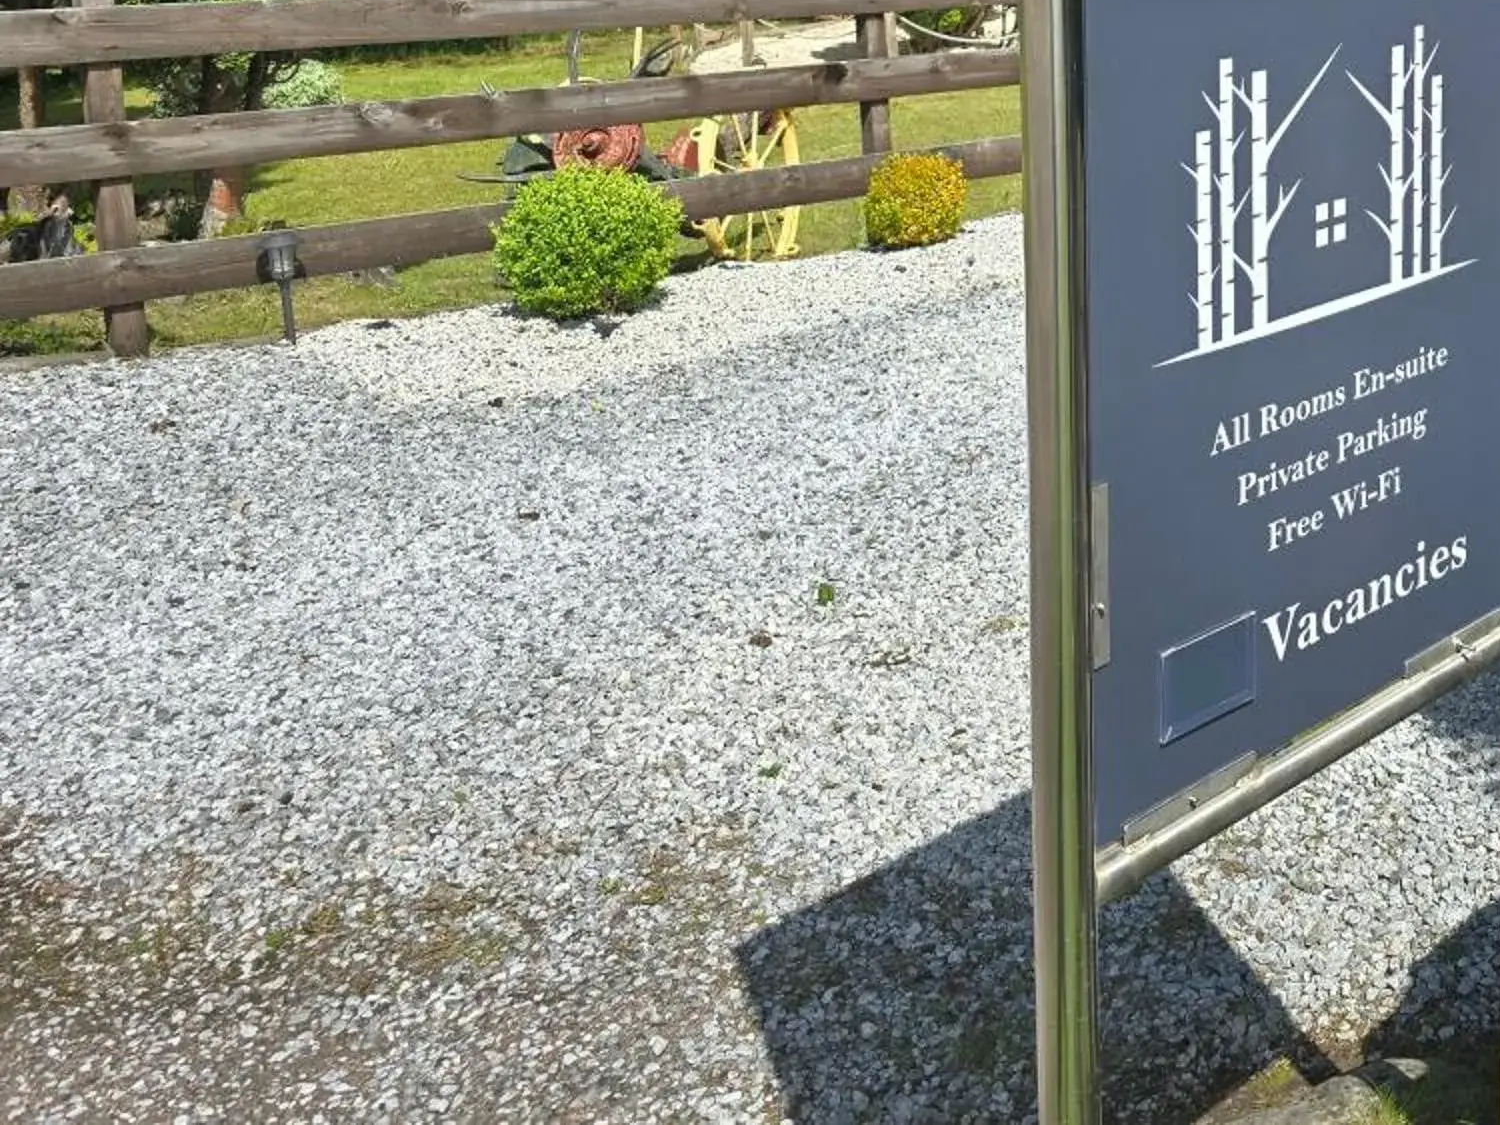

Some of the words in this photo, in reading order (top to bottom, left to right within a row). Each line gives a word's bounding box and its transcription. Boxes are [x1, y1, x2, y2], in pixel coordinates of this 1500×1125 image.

[1209, 412, 1251, 457] All
[1259, 387, 1347, 438] Rooms
[1352, 346, 1449, 401] En-suite
[1236, 450, 1329, 506] Private
[1336, 408, 1429, 464] Parking
[1267, 510, 1324, 553] Free
[1330, 466, 1402, 521] Wi-Fi
[1261, 534, 1469, 663] Vacancies
